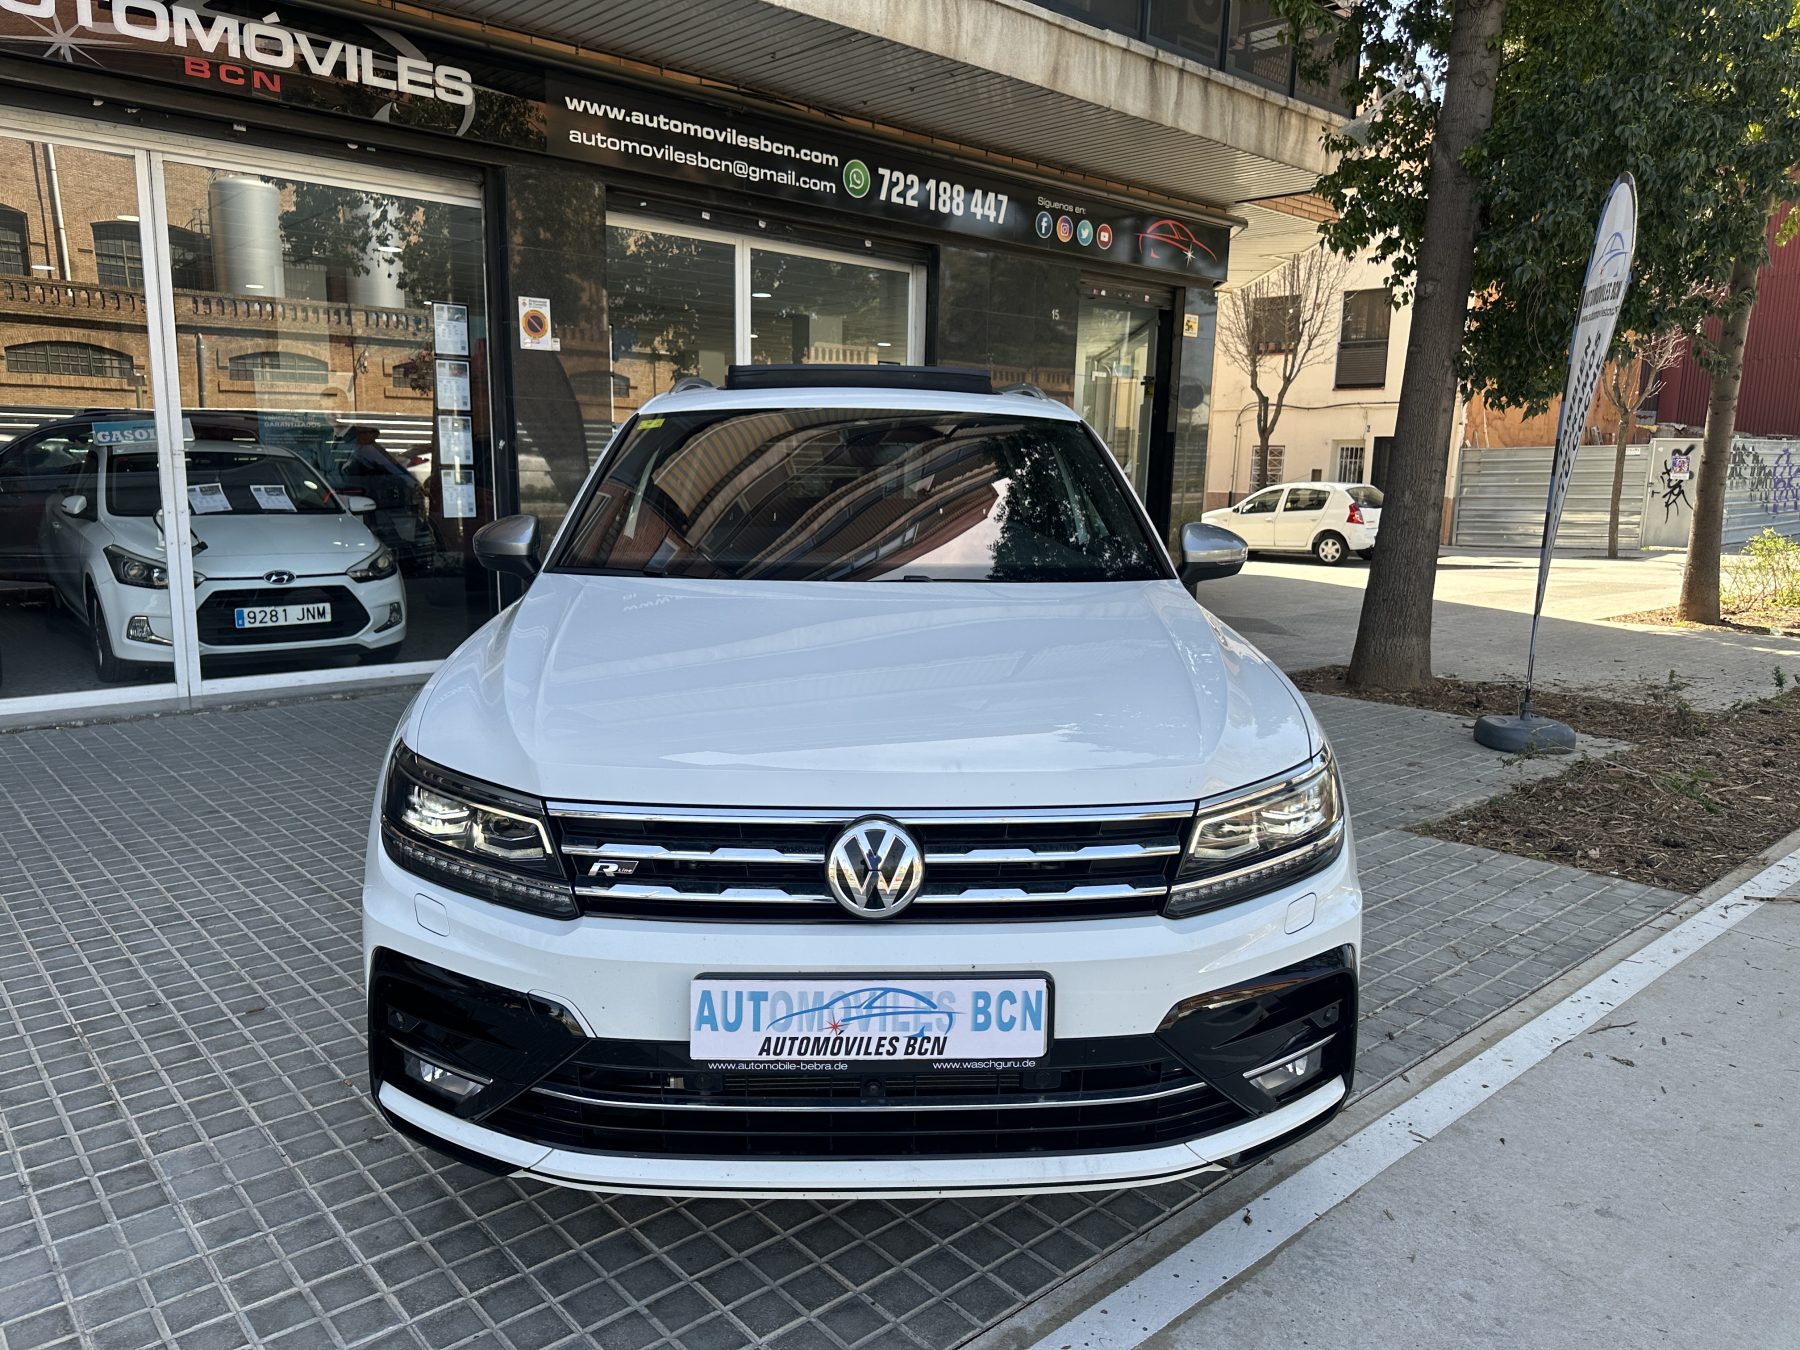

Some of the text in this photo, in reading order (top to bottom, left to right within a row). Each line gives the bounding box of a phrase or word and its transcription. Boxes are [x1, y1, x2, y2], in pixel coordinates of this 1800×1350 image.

[184, 56, 281, 93] BCN
[565, 96, 839, 167] www.automovilesbcn.com
[569, 129, 836, 194] automovilesbcn@gmail.com
[878, 167, 1009, 225] 722 188 447
[1052, 309, 1060, 320] 15
[247, 605, 327, 625] 9281 JNM
[970, 990, 1043, 1033] BCN
[903, 1036, 948, 1057] BCN
[708, 1061, 848, 1071] www.automobile-bebra.de
[932, 1059, 1036, 1070] www.waschguru.de
